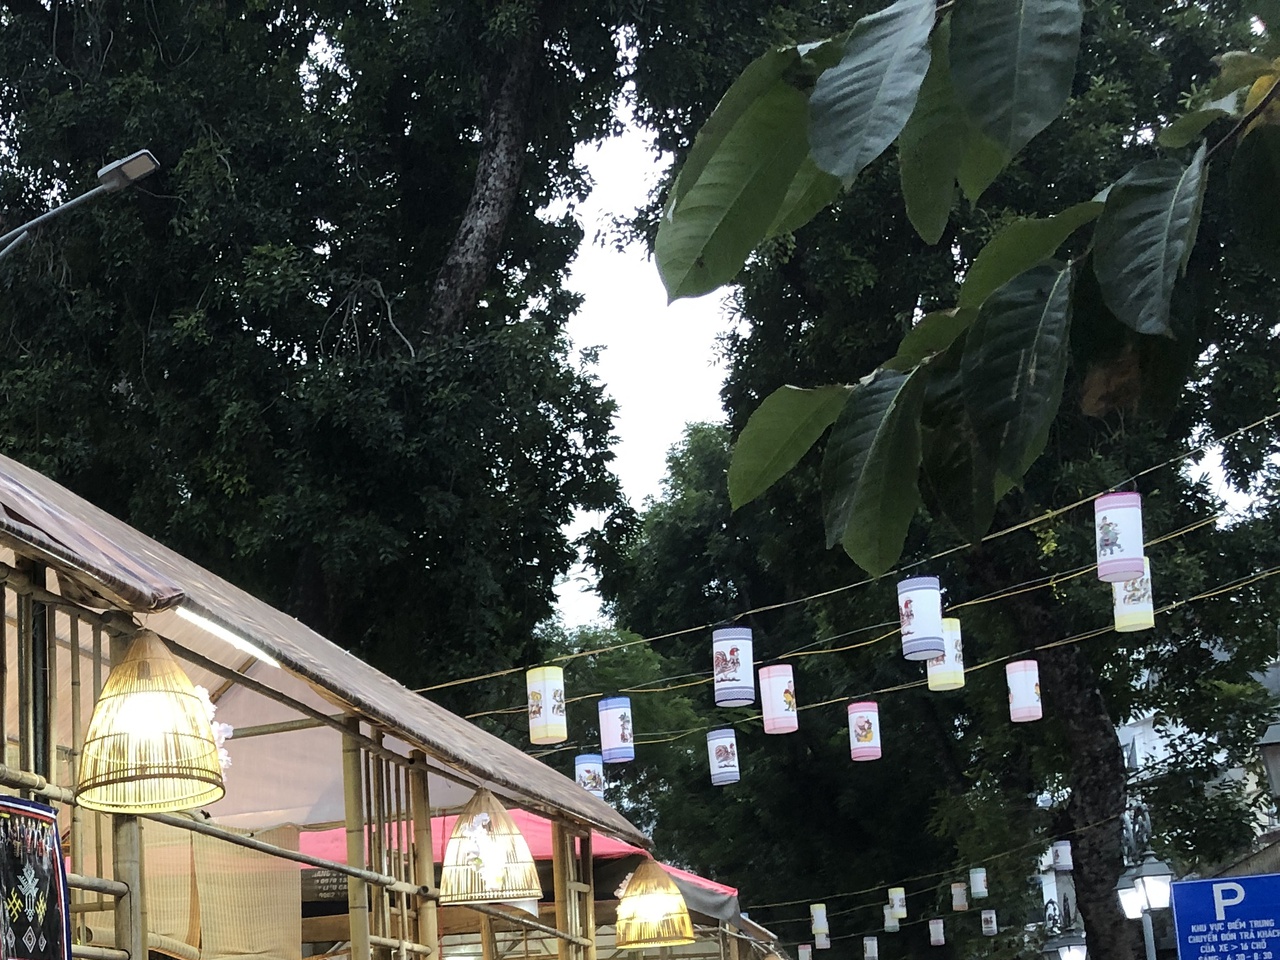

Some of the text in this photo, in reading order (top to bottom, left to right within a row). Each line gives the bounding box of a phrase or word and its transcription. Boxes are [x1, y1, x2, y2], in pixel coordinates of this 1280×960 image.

[1212, 882, 1245, 921] P
[1191, 918, 1275, 933] KHU VỰC ĐIỂM TRUNG
[1188, 931, 1218, 944] CHUYỂN
[1221, 931, 1237, 942] ĐÓN
[1239, 929, 1255, 940] TRẢ
[1200, 943, 1215, 953] CỦA
[1219, 944, 1229, 952] XE
[1240, 943, 1249, 951] 16
[1251, 939, 1267, 950] CHỖ
